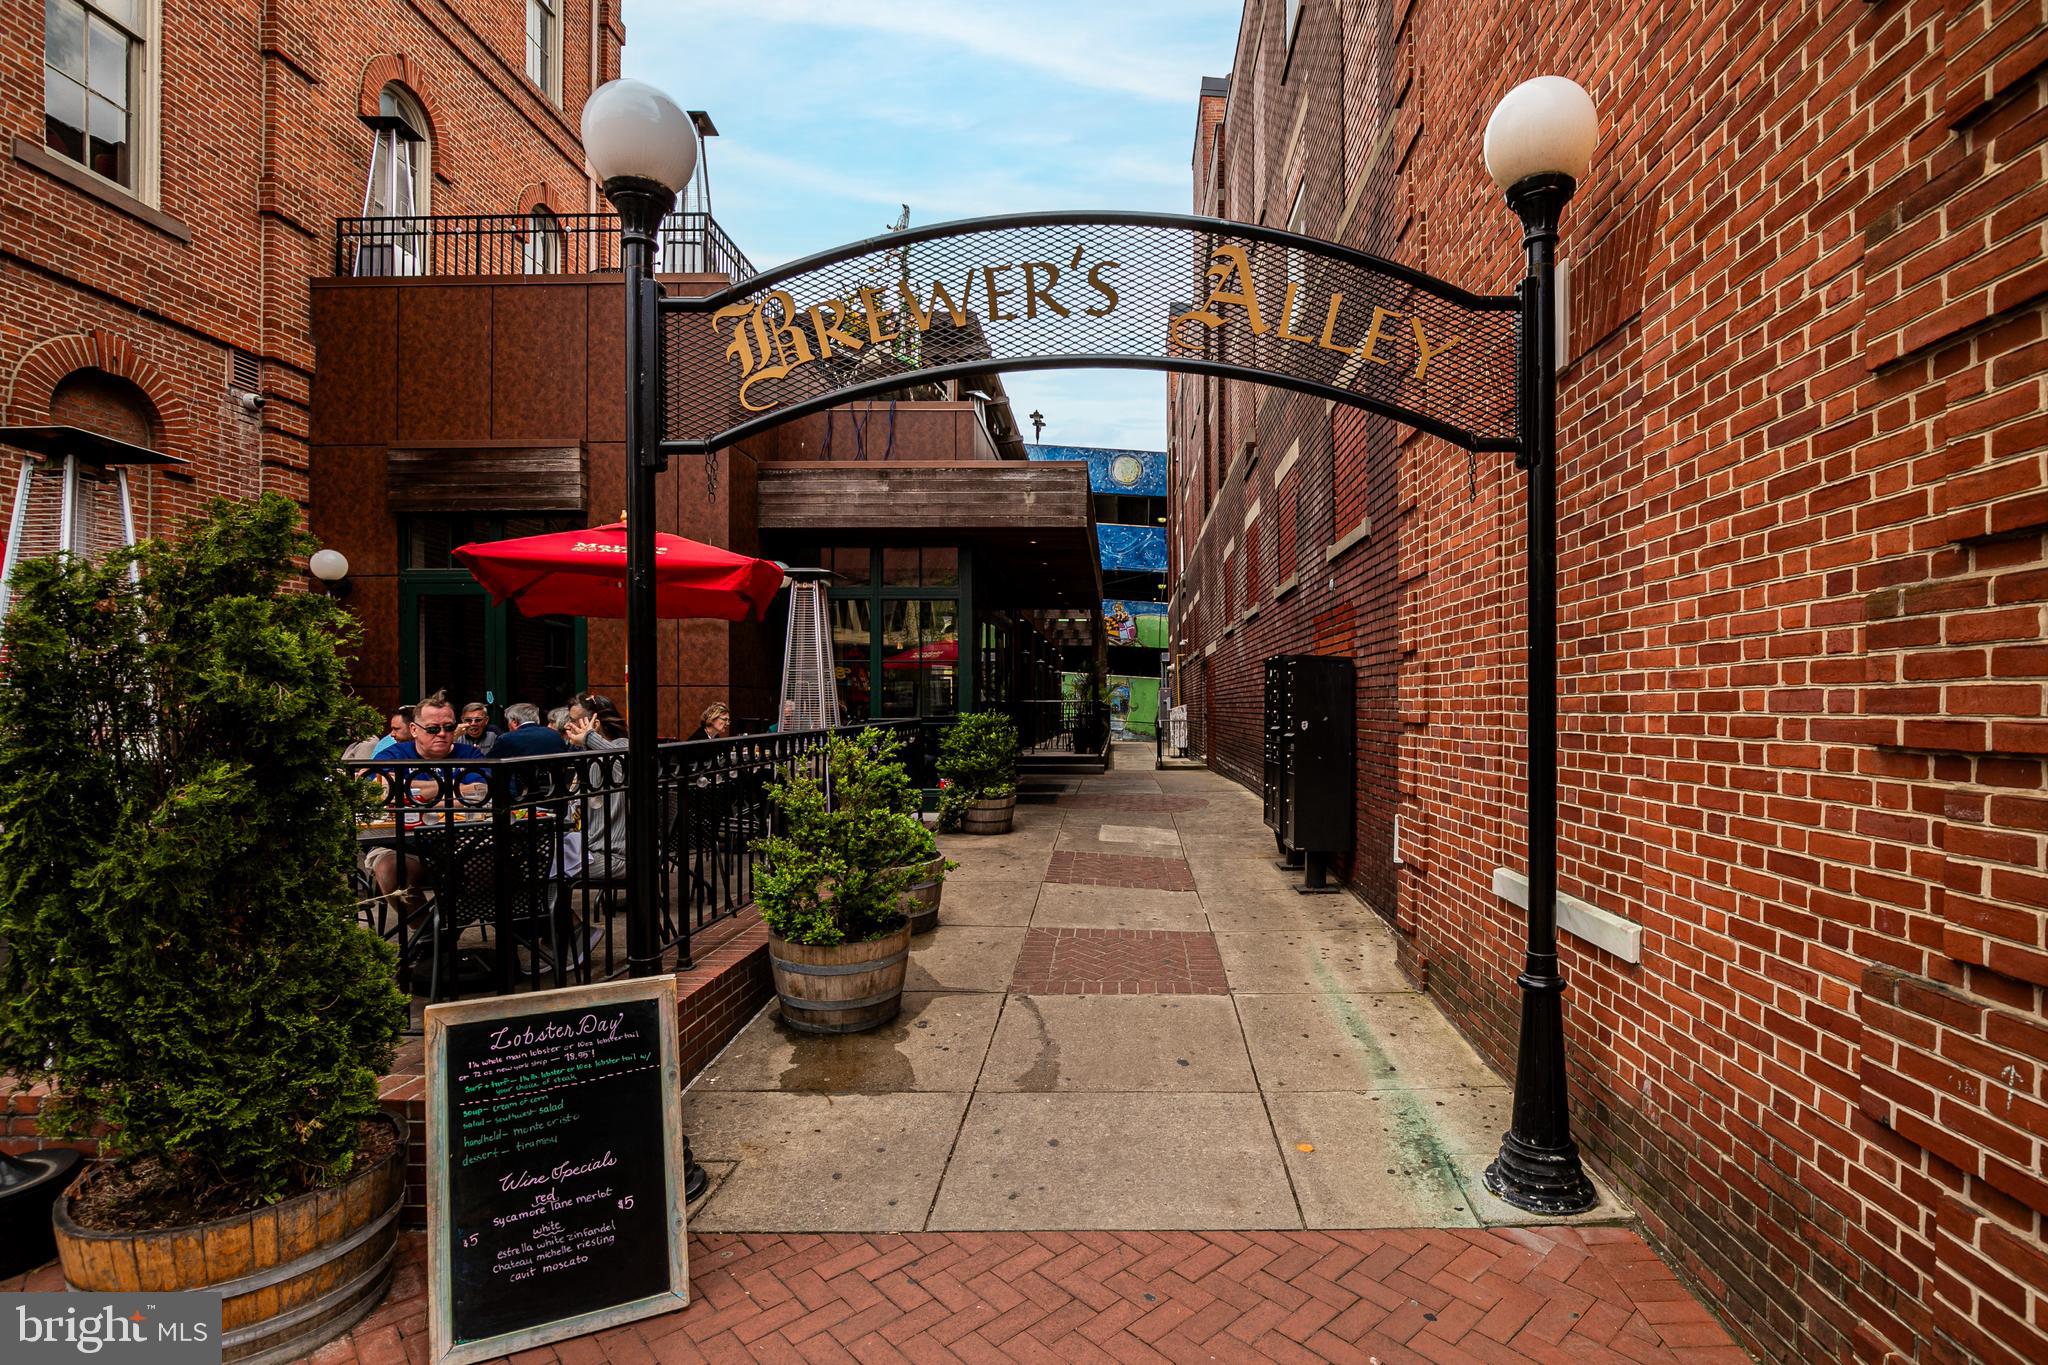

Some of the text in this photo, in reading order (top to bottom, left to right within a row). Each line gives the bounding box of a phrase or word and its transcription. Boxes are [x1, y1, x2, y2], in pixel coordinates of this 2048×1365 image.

[712, 244, 1461, 411] BREWER'S ALLEY
[490, 1012, 624, 1050] Lobster Day
[482, 1057, 503, 1066] whole
[506, 1052, 528, 1060] main
[529, 1046, 561, 1056] lobster
[597, 1035, 623, 1045] lobster
[624, 1030, 640, 1039] tail
[513, 1062, 529, 1071] york
[531, 1058, 548, 1067] strip
[540, 1068, 565, 1078] lobster
[594, 1057, 620, 1067] lobster
[621, 1053, 636, 1062] tail
[495, 1086, 512, 1096] your
[515, 1082, 539, 1090] choice
[553, 1073, 577, 1083] steak
[492, 1102, 518, 1112] cream
[494, 1109, 537, 1124] southwest
[538, 1098, 564, 1114] salad
[512, 1122, 545, 1136] monte
[547, 1113, 580, 1127] cristo
[516, 1135, 558, 1152] tiramisu
[499, 1150, 618, 1192] Wine Specials
[534, 1187, 556, 1204] red
[617, 1195, 635, 1210] $5
[493, 1187, 613, 1228] sycamore lane merlot
[497, 1219, 616, 1260] estrella white zinfandel
[532, 1220, 562, 1236] white
[463, 1232, 480, 1248] $5
[492, 1234, 616, 1274] chateau michelle riesling
[542, 1255, 589, 1274] moscato
